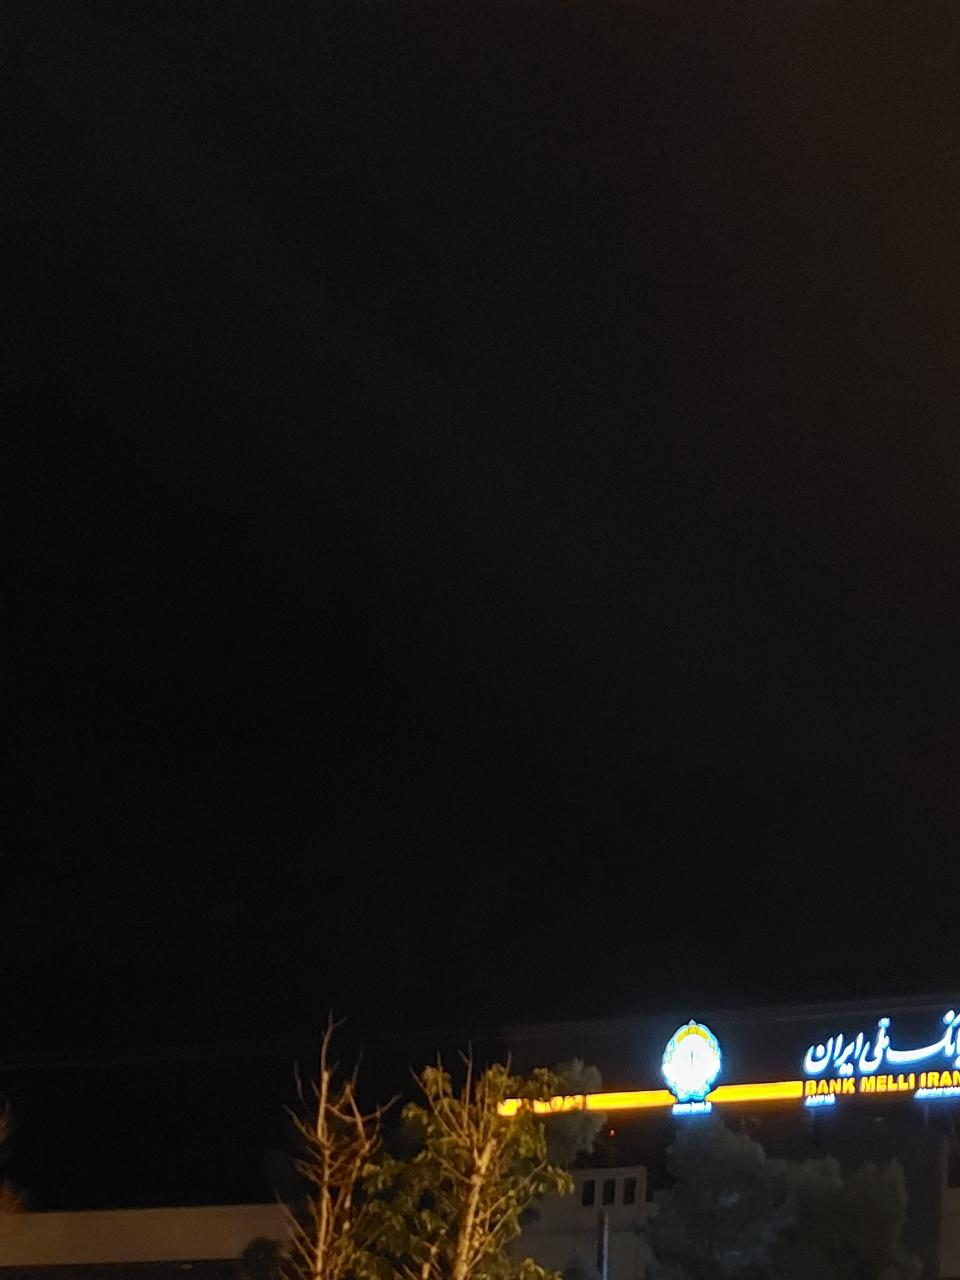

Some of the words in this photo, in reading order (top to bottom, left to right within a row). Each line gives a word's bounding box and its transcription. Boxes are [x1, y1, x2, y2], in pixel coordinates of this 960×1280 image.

[804, 1032, 864, 1076] ایران
[805, 1077, 856, 1096] BANK
[860, 1073, 916, 1093] MELLI
